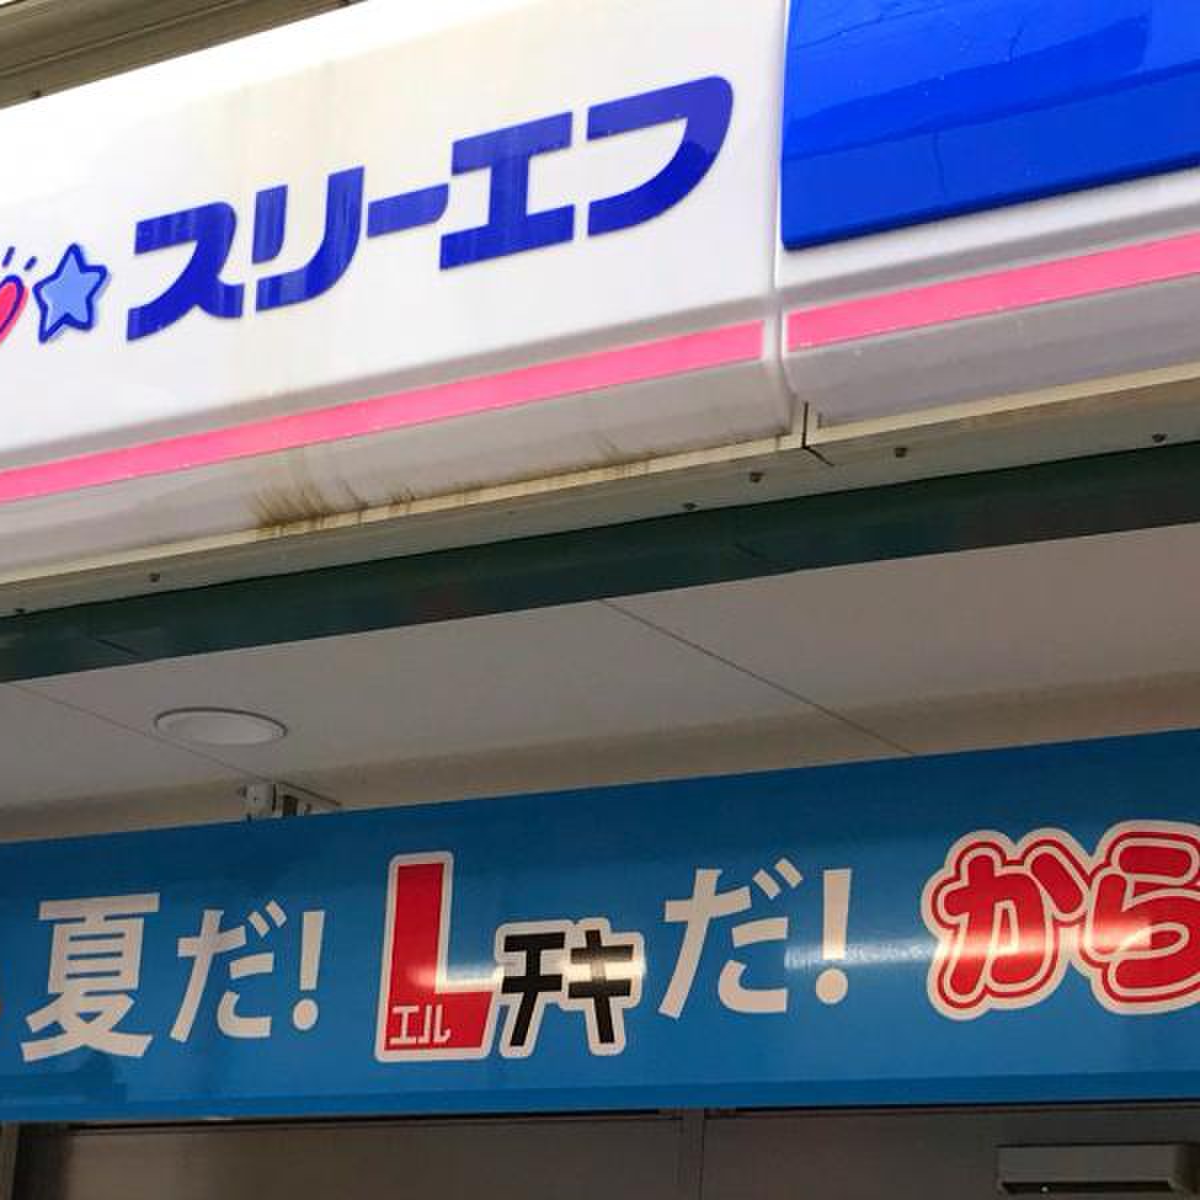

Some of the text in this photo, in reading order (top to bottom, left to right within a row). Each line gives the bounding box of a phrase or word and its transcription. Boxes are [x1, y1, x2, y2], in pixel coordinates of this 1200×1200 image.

[126, 75, 735, 341] スリーエフ
[20, 892, 325, 1062] 夏だ!
[389, 1004, 451, 1047] エル
